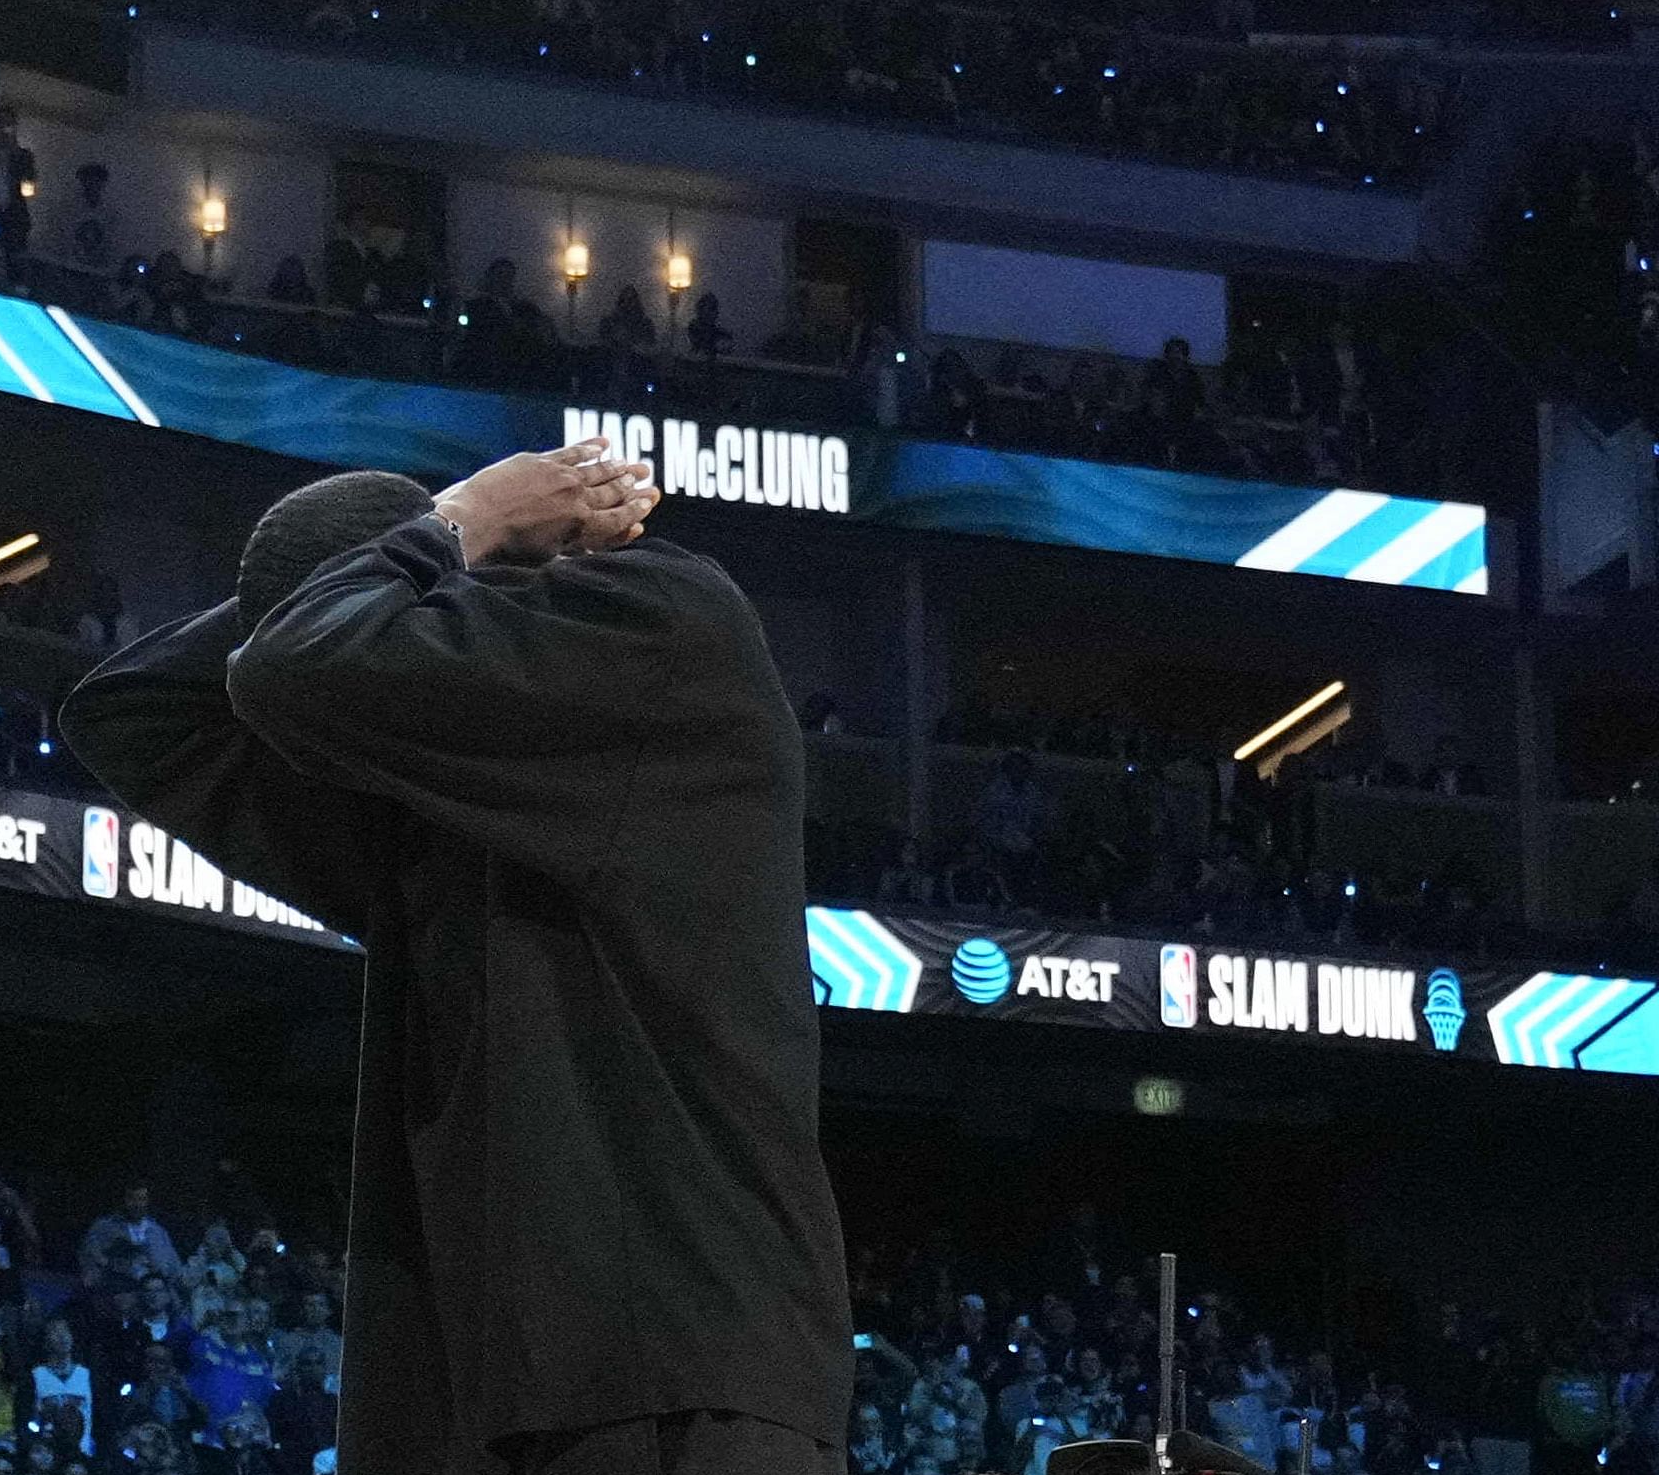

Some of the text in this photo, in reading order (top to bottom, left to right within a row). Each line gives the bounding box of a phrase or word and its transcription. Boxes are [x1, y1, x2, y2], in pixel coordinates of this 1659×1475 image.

[663, 418, 850, 514] McCLUNG
[1016, 955, 1120, 1004] AT&T
[1207, 953, 1418, 1044] SLAM DUNK
